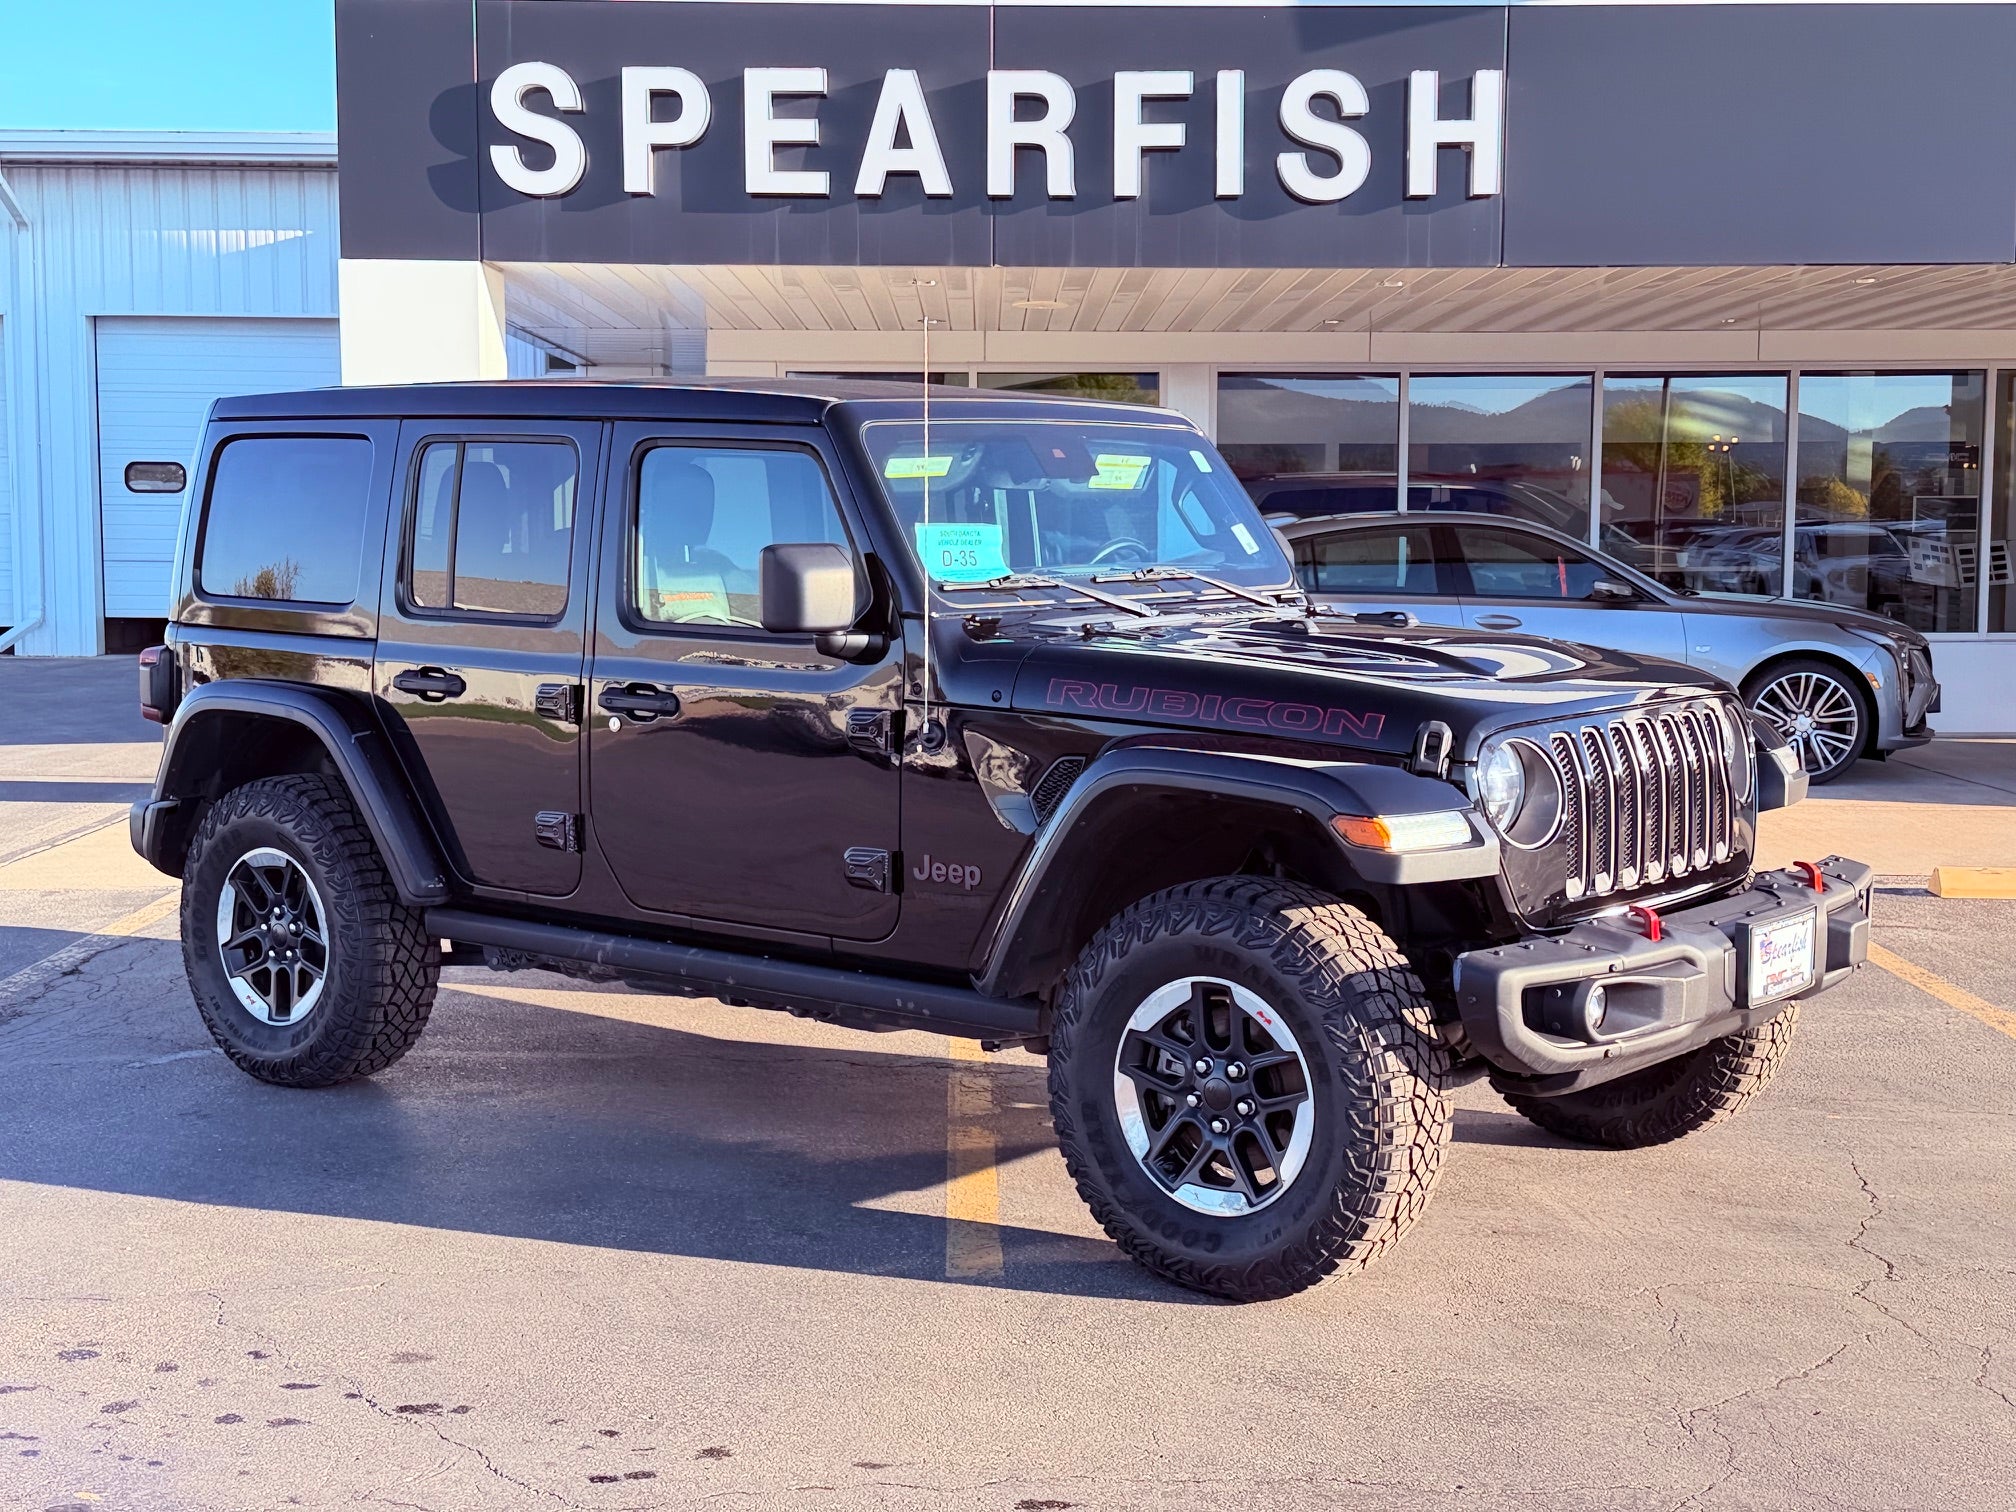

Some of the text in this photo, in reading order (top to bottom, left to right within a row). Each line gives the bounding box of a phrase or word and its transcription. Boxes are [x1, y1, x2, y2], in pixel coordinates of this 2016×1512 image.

[489, 61, 1505, 204] SPEARFISH
[942, 550, 978, 567] D-35
[1046, 678, 1386, 740] RUBICON
[912, 854, 983, 891] Jeep
